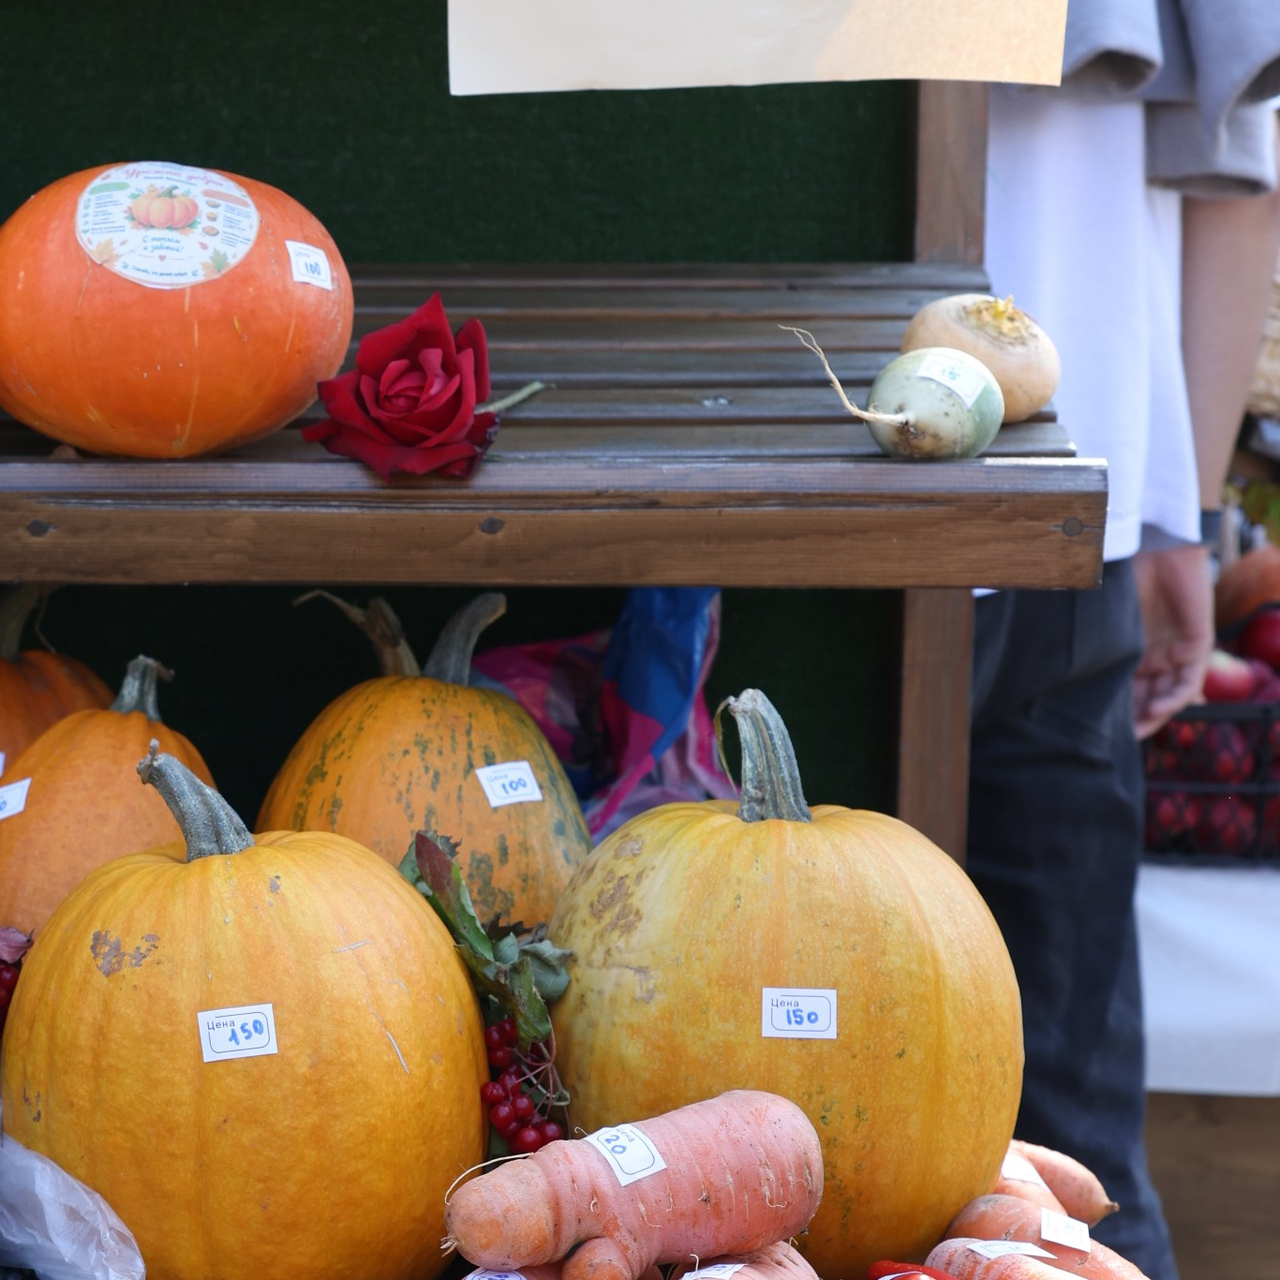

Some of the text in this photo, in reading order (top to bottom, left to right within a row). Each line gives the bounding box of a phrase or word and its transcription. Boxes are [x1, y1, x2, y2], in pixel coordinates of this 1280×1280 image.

[502, 778, 527, 795] 100
[771, 998, 800, 1008] Цена
[786, 1008, 819, 1025] 150
[207, 1020, 235, 1031] Цена
[228, 1019, 264, 1046] 150
[605, 1134, 627, 1154] 20
